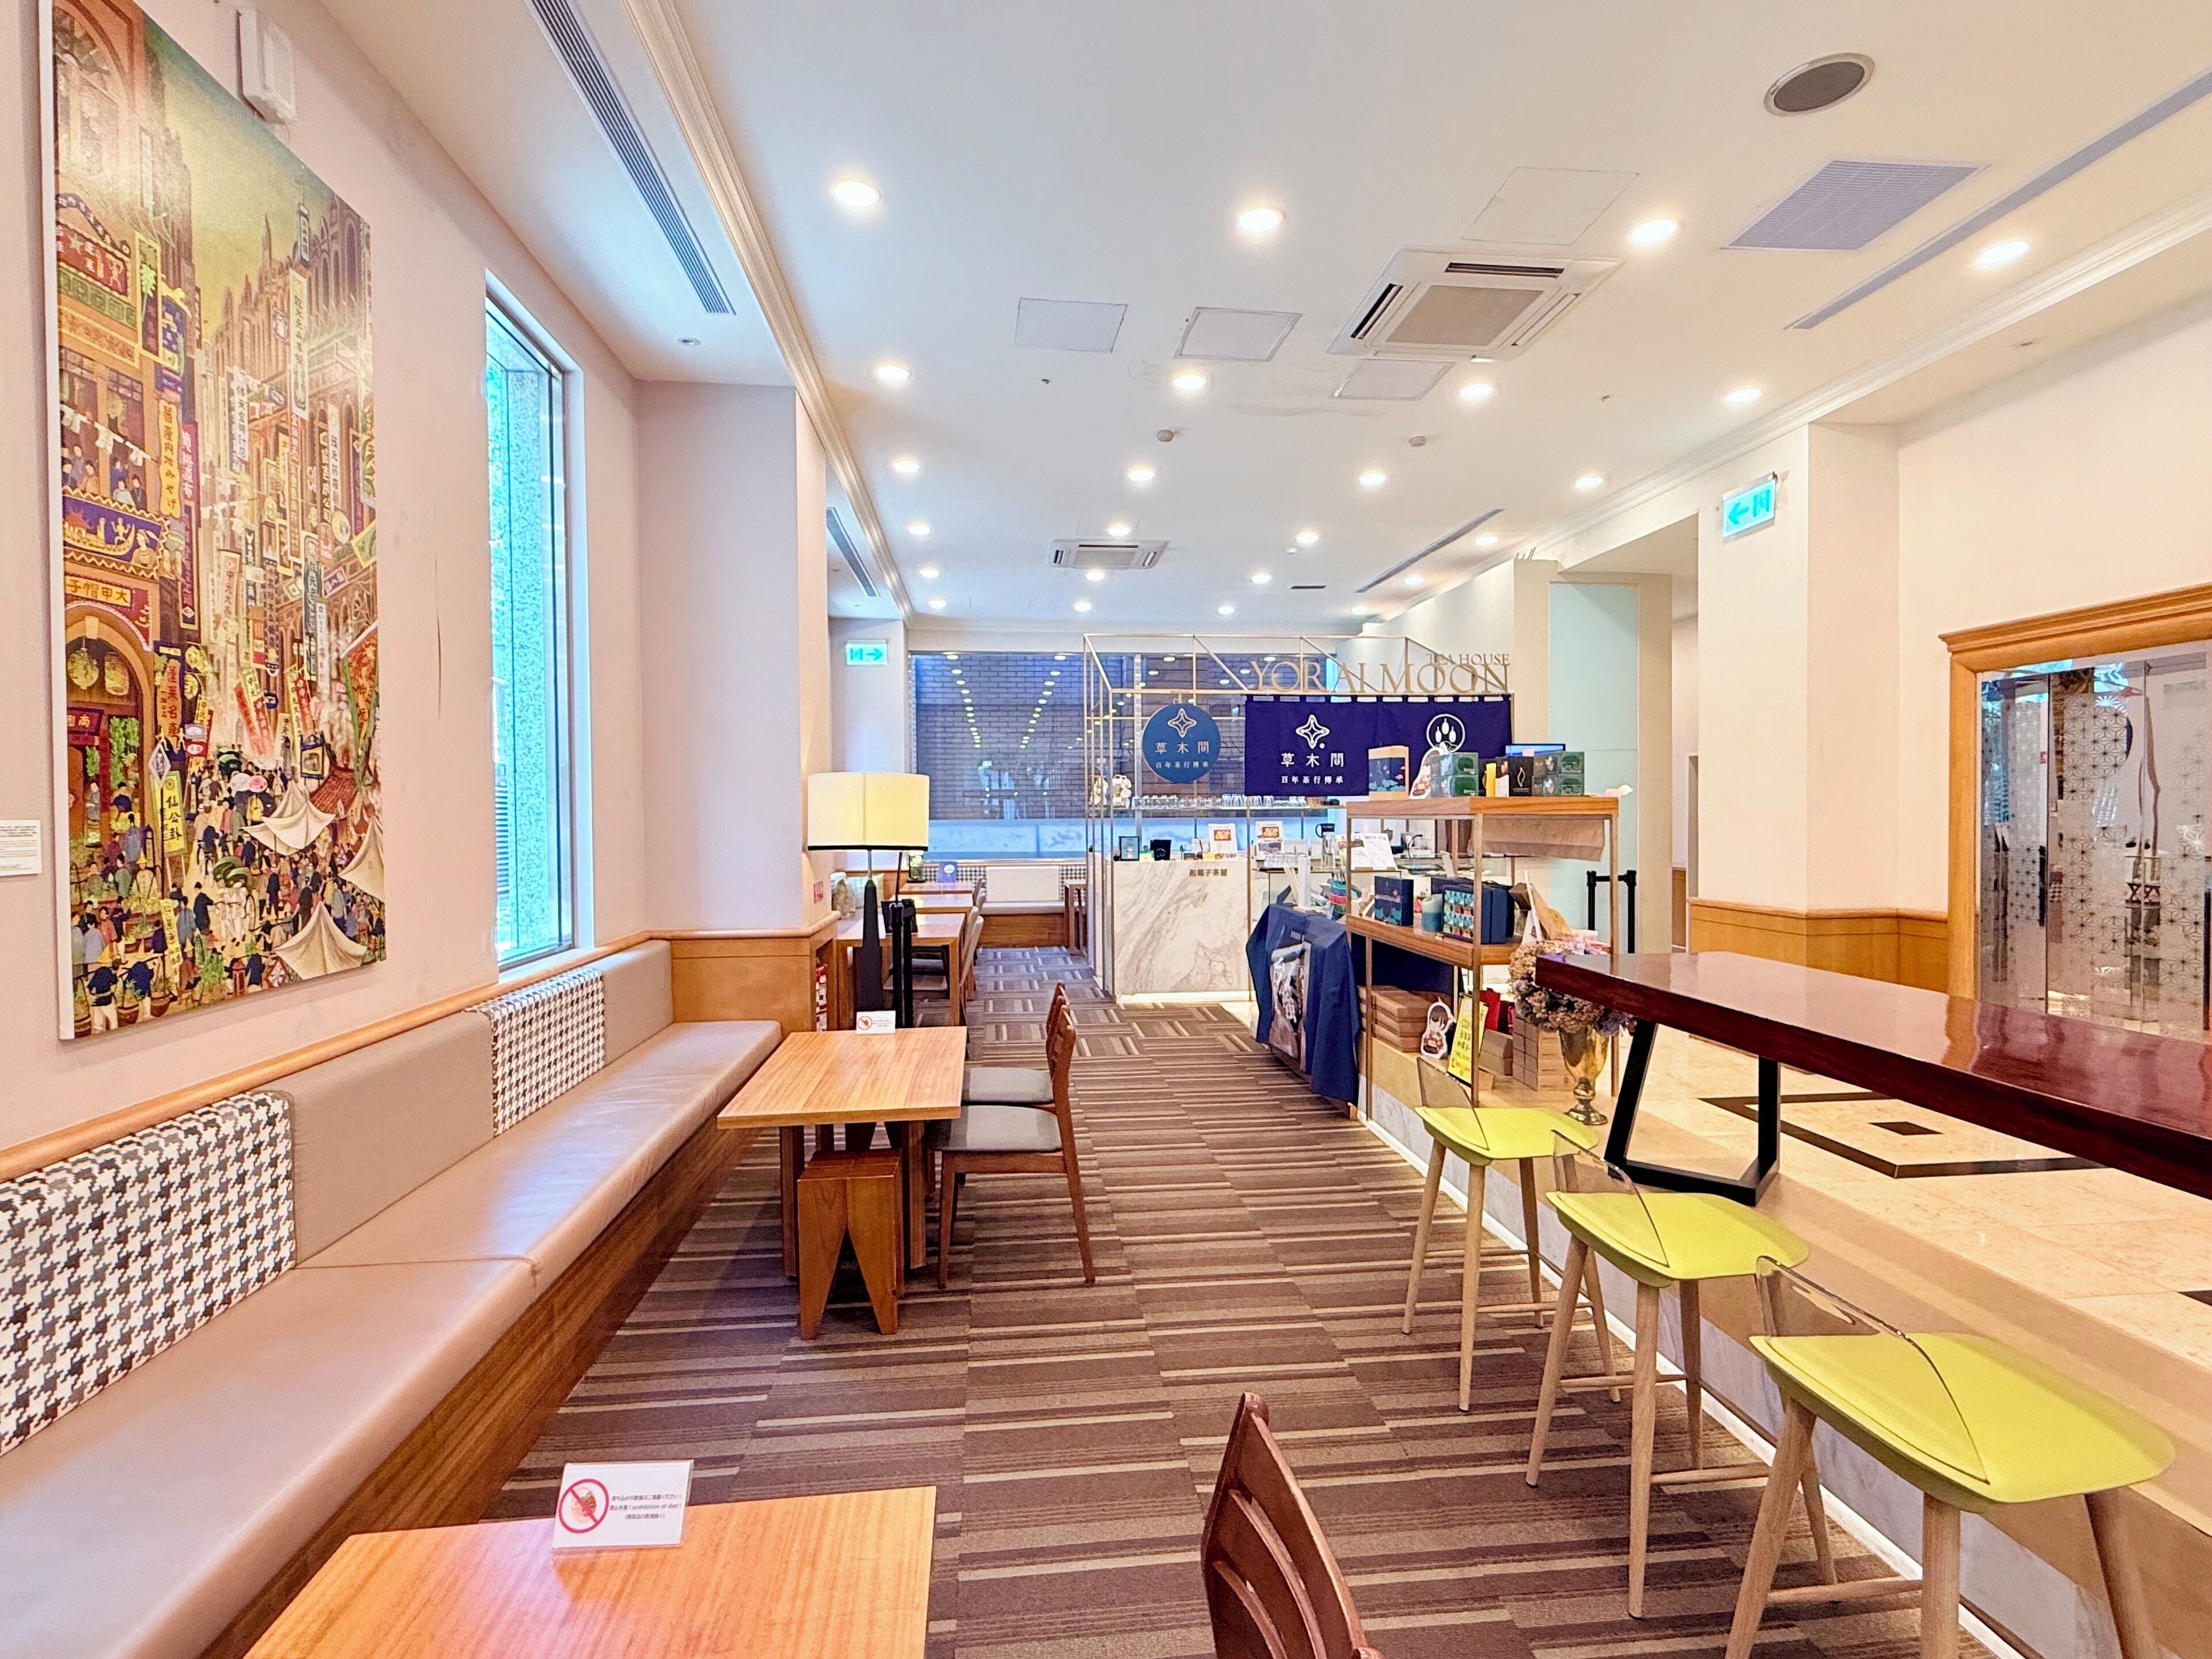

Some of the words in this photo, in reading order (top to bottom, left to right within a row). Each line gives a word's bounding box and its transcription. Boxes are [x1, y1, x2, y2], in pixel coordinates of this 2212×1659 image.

[1427, 653, 1455, 665] TEA
[1459, 654, 1510, 665] HOUSE
[1155, 741, 1210, 755] 草木間
[1281, 752, 1344, 767] 草木間
